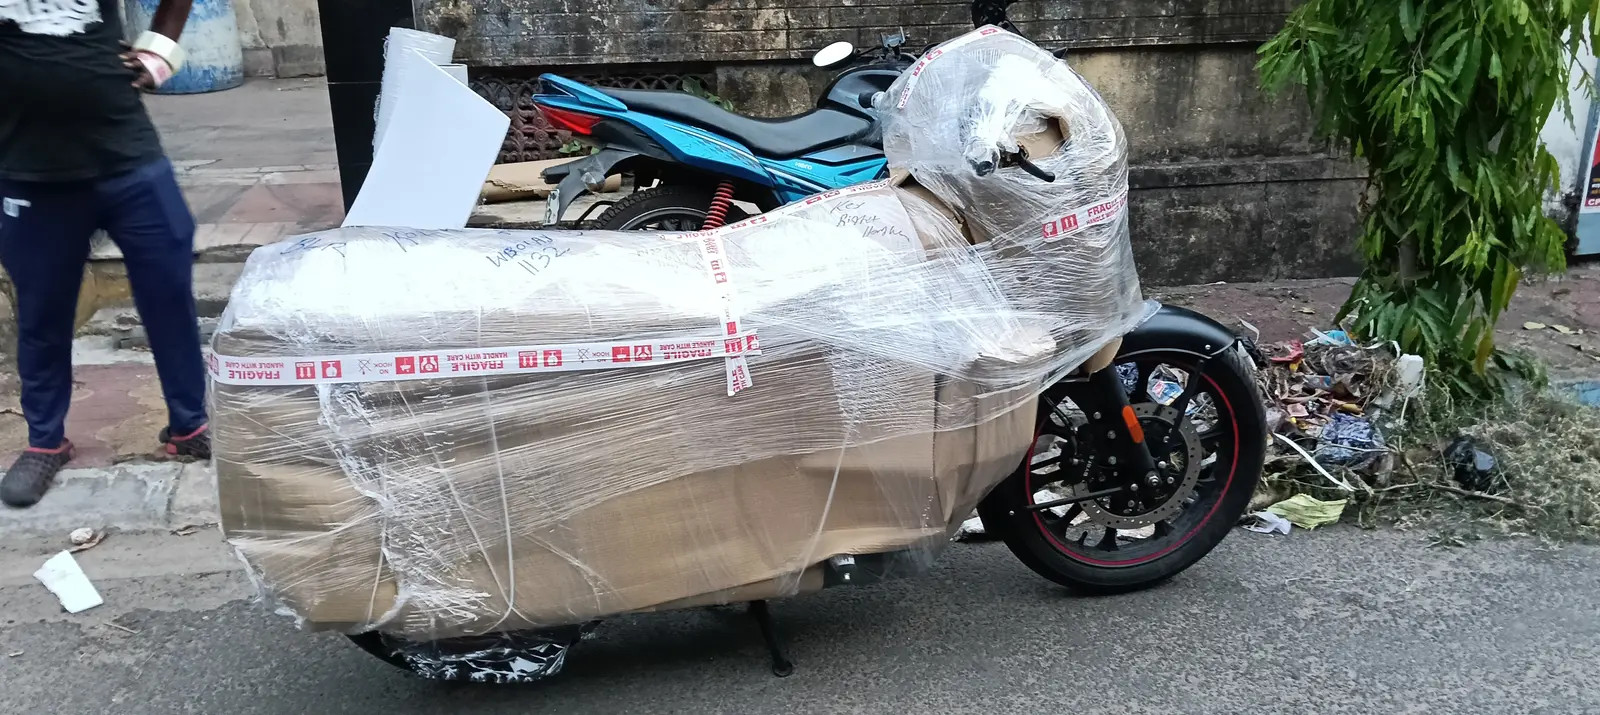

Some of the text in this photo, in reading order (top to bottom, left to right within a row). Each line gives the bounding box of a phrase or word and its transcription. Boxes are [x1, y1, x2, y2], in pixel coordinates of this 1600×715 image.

[446, 351, 508, 362] HANDLE WITH CARE
[663, 348, 712, 360] FRAGILE
[224, 360, 285, 369] HANDLE WITH CARE
[451, 360, 504, 373] FRAGILE
[228, 369, 281, 380] FRAGILE
